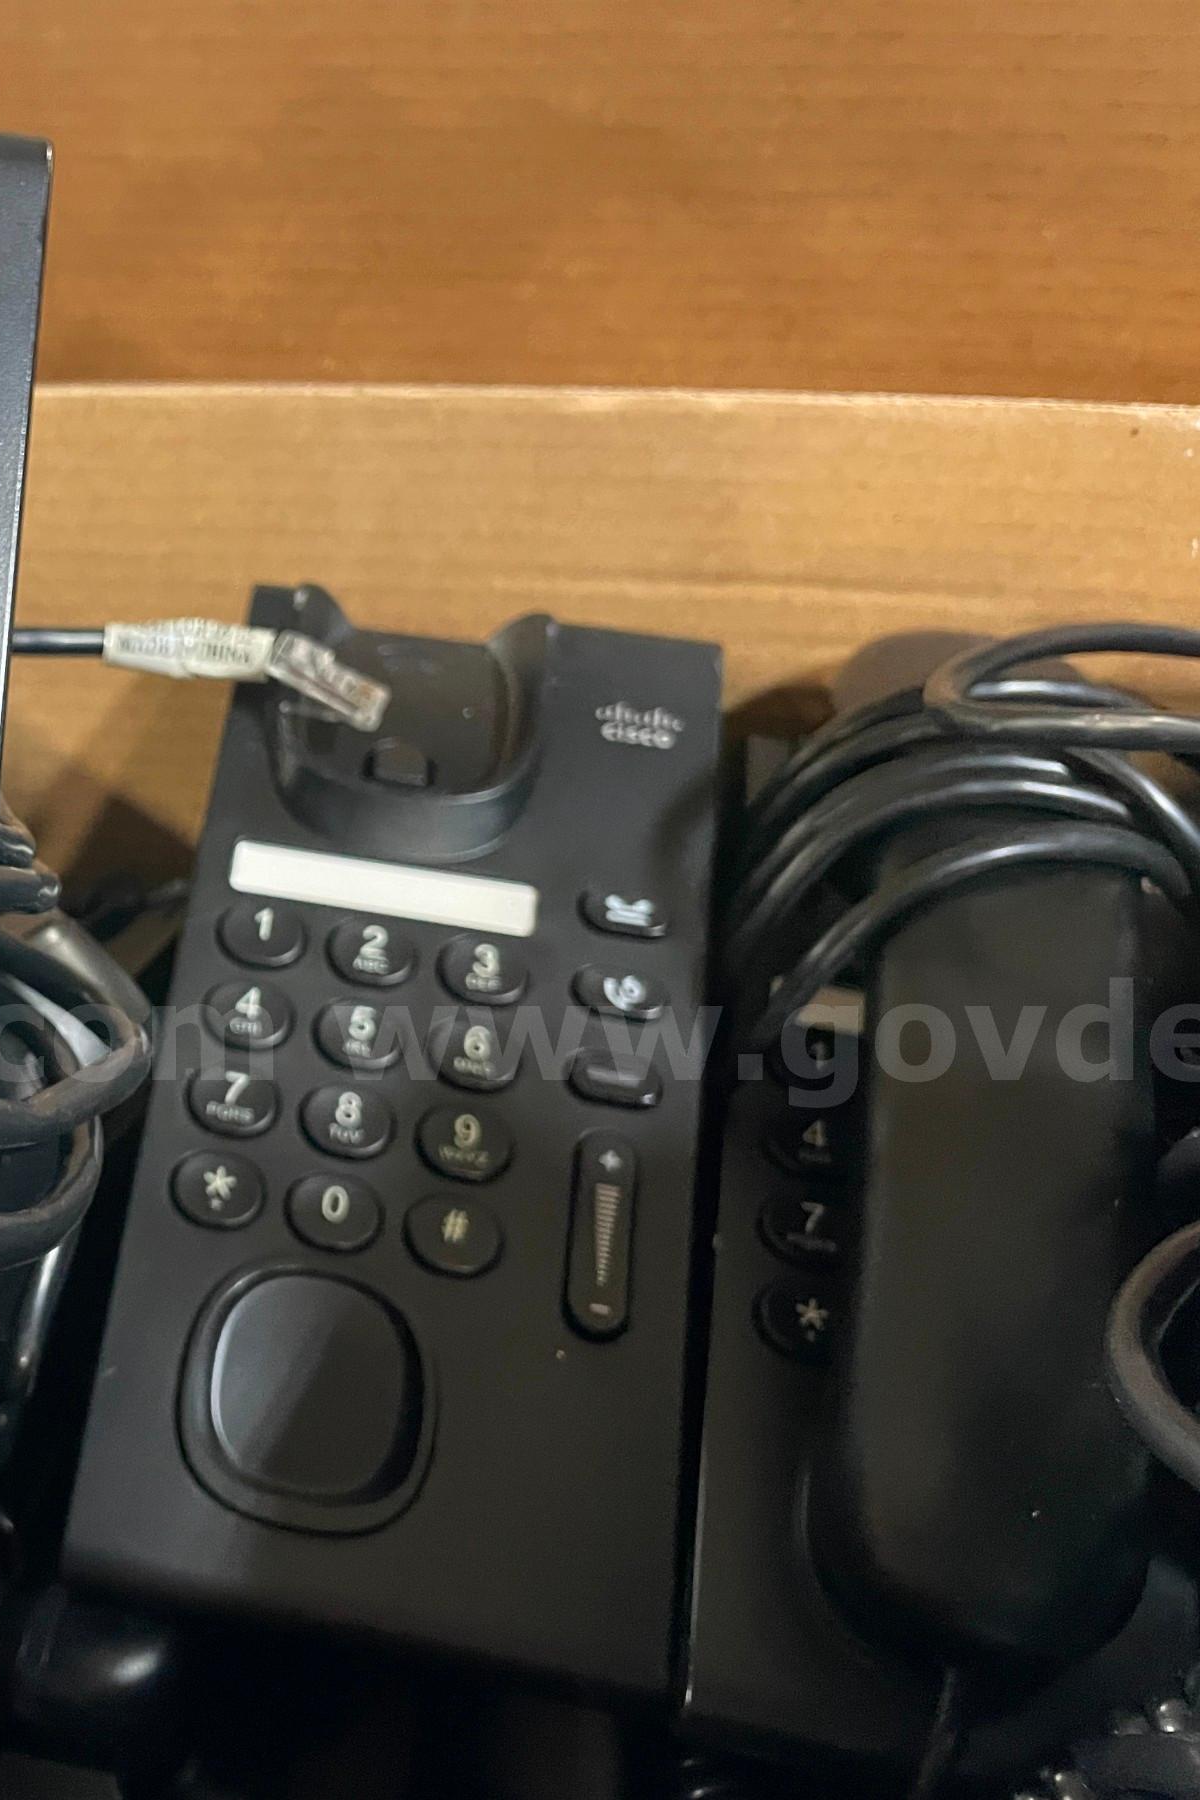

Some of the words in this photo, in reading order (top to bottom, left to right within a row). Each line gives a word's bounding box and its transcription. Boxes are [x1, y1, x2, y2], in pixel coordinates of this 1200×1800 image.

[254, 906, 275, 942] 1
[360, 924, 389, 957] 2
[472, 943, 500, 977] 3
[235, 986, 262, 1020] 4
[348, 1004, 377, 1041] 5
[464, 1024, 492, 1061] 6
[225, 1069, 250, 1104] 7
[335, 1090, 363, 1129] 8
[453, 1113, 482, 1148] 9
[802, 1118, 828, 1148] 4
[321, 1184, 350, 1224] 0
[801, 1200, 824, 1234] 7
